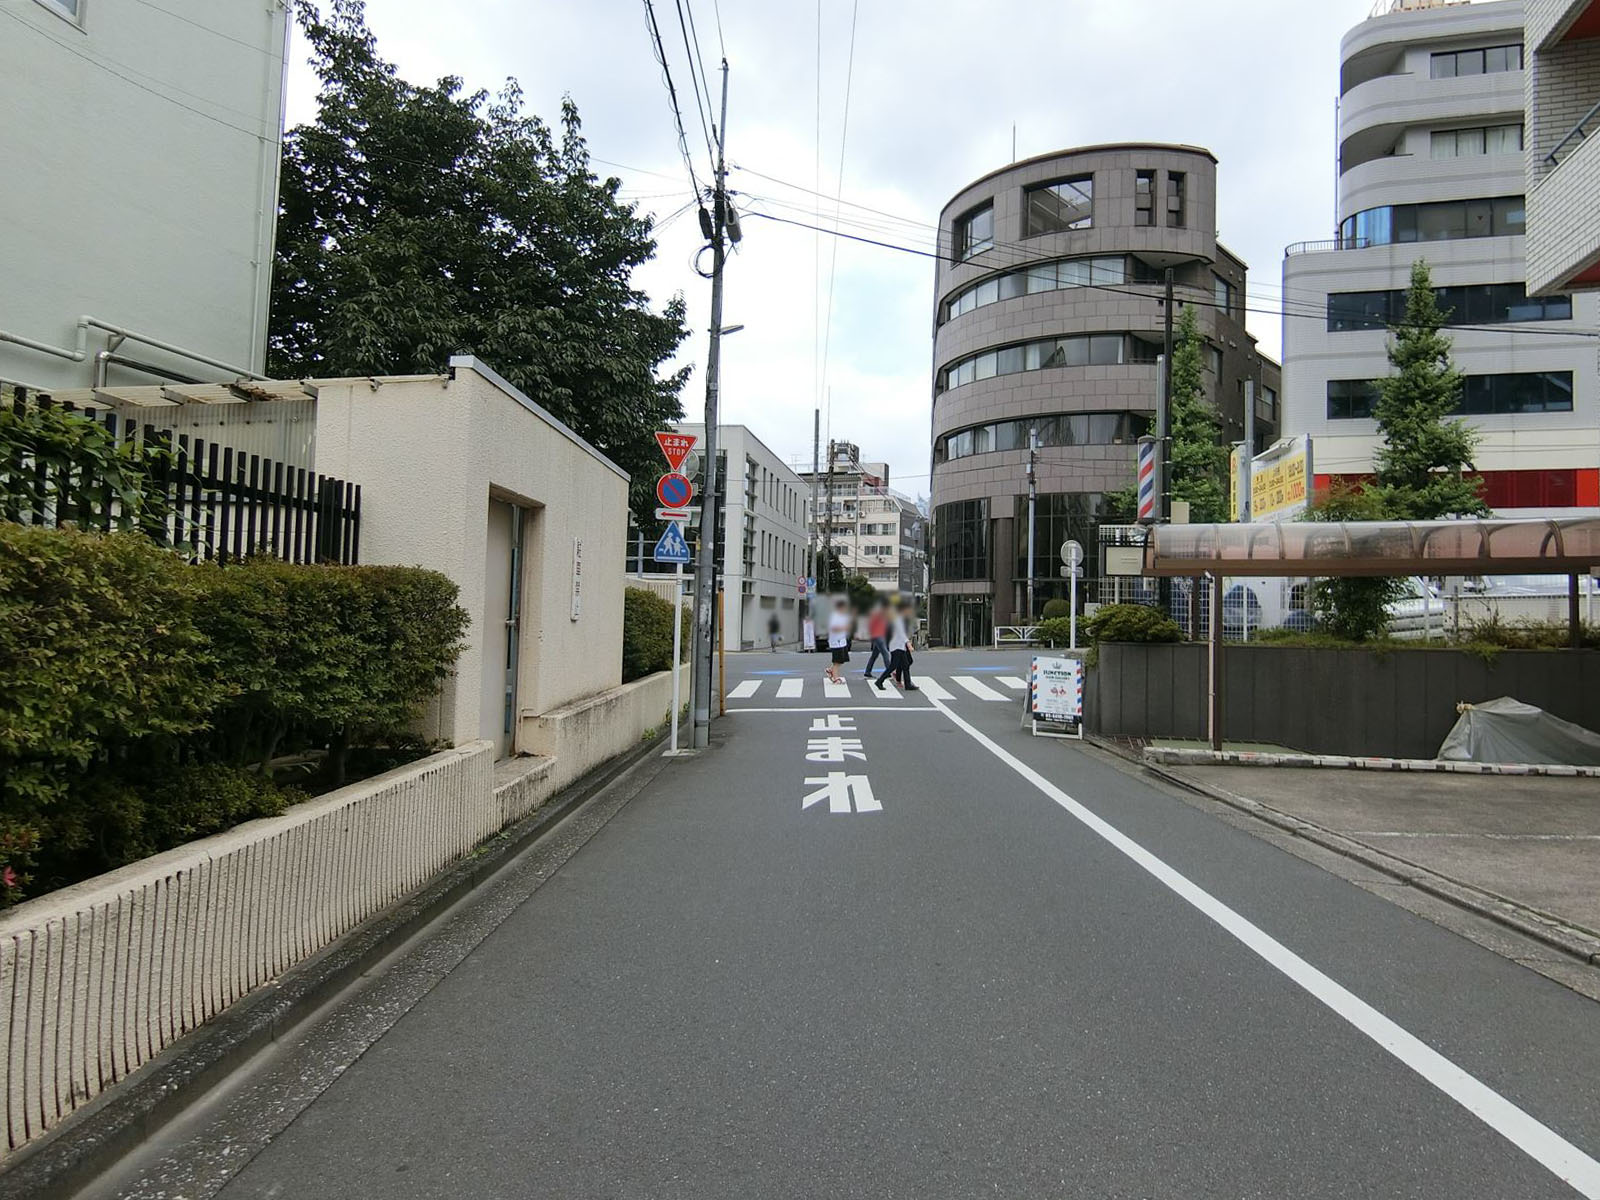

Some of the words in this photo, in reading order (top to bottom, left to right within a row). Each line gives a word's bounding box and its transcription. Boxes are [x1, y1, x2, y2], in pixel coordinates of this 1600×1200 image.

[664, 437, 688, 447] 止まれ
[668, 448, 686, 456] STOP
[802, 714, 883, 813] 止まれ
